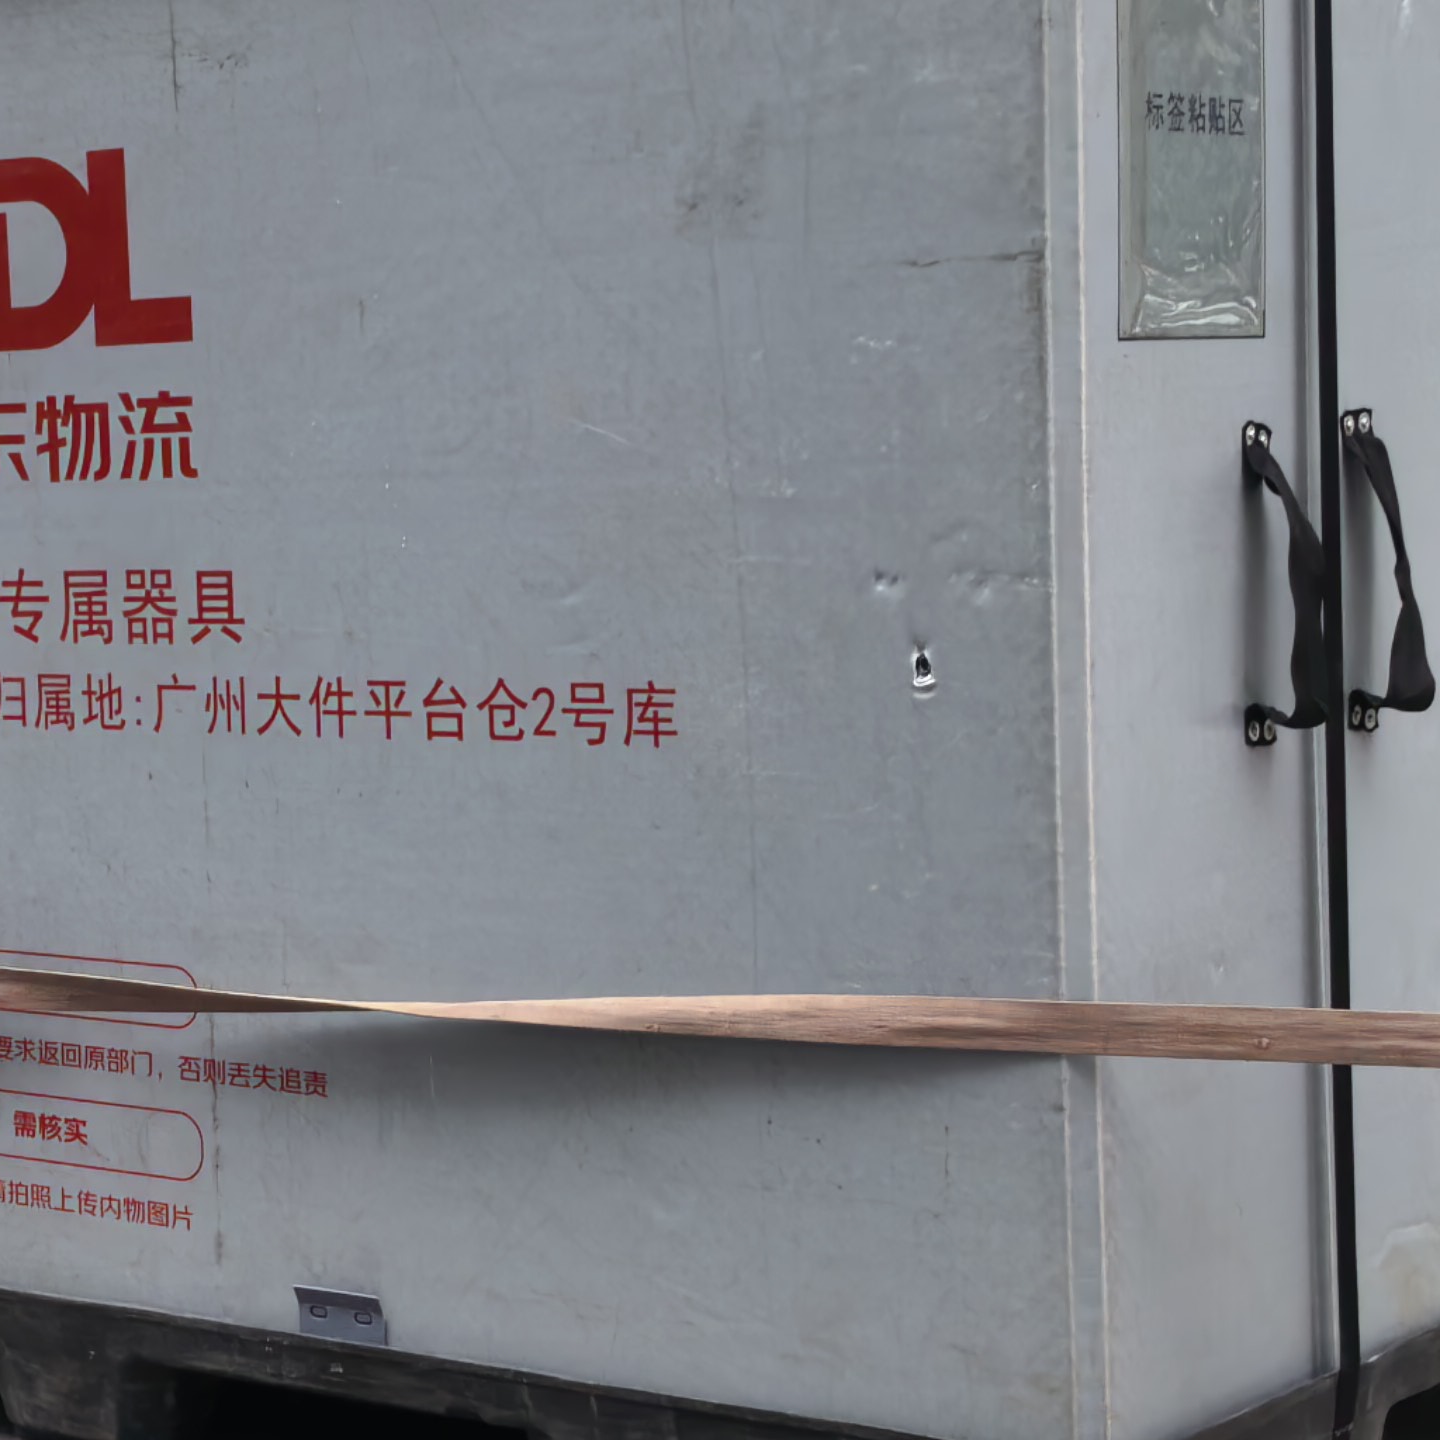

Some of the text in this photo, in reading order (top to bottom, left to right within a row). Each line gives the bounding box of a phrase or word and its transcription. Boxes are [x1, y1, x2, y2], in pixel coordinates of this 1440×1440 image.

[1144, 91, 1246, 136] 标签粘贴区
[14, 1110, 88, 1145] 需核实
